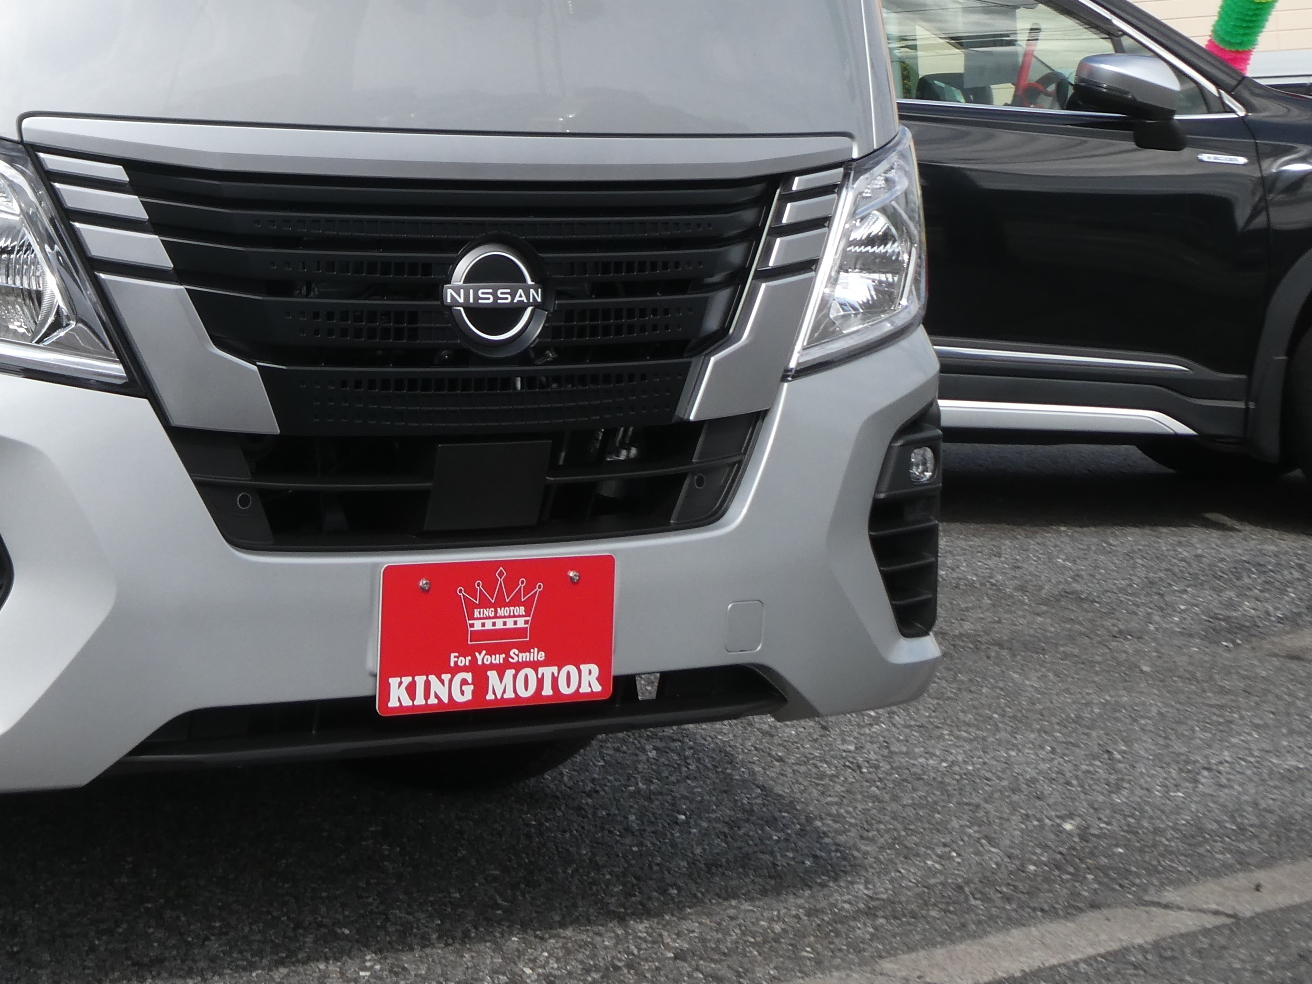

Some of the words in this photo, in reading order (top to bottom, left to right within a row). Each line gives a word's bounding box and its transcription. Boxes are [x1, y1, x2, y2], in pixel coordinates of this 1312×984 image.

[446, 288, 542, 303] NISSAN
[474, 607, 495, 618] KING
[497, 606, 526, 617] MOTOR
[450, 652, 471, 667] For
[475, 650, 506, 666] Your
[508, 647, 546, 664] Smile
[387, 671, 475, 708] KING
[485, 663, 603, 701] MOTOR
